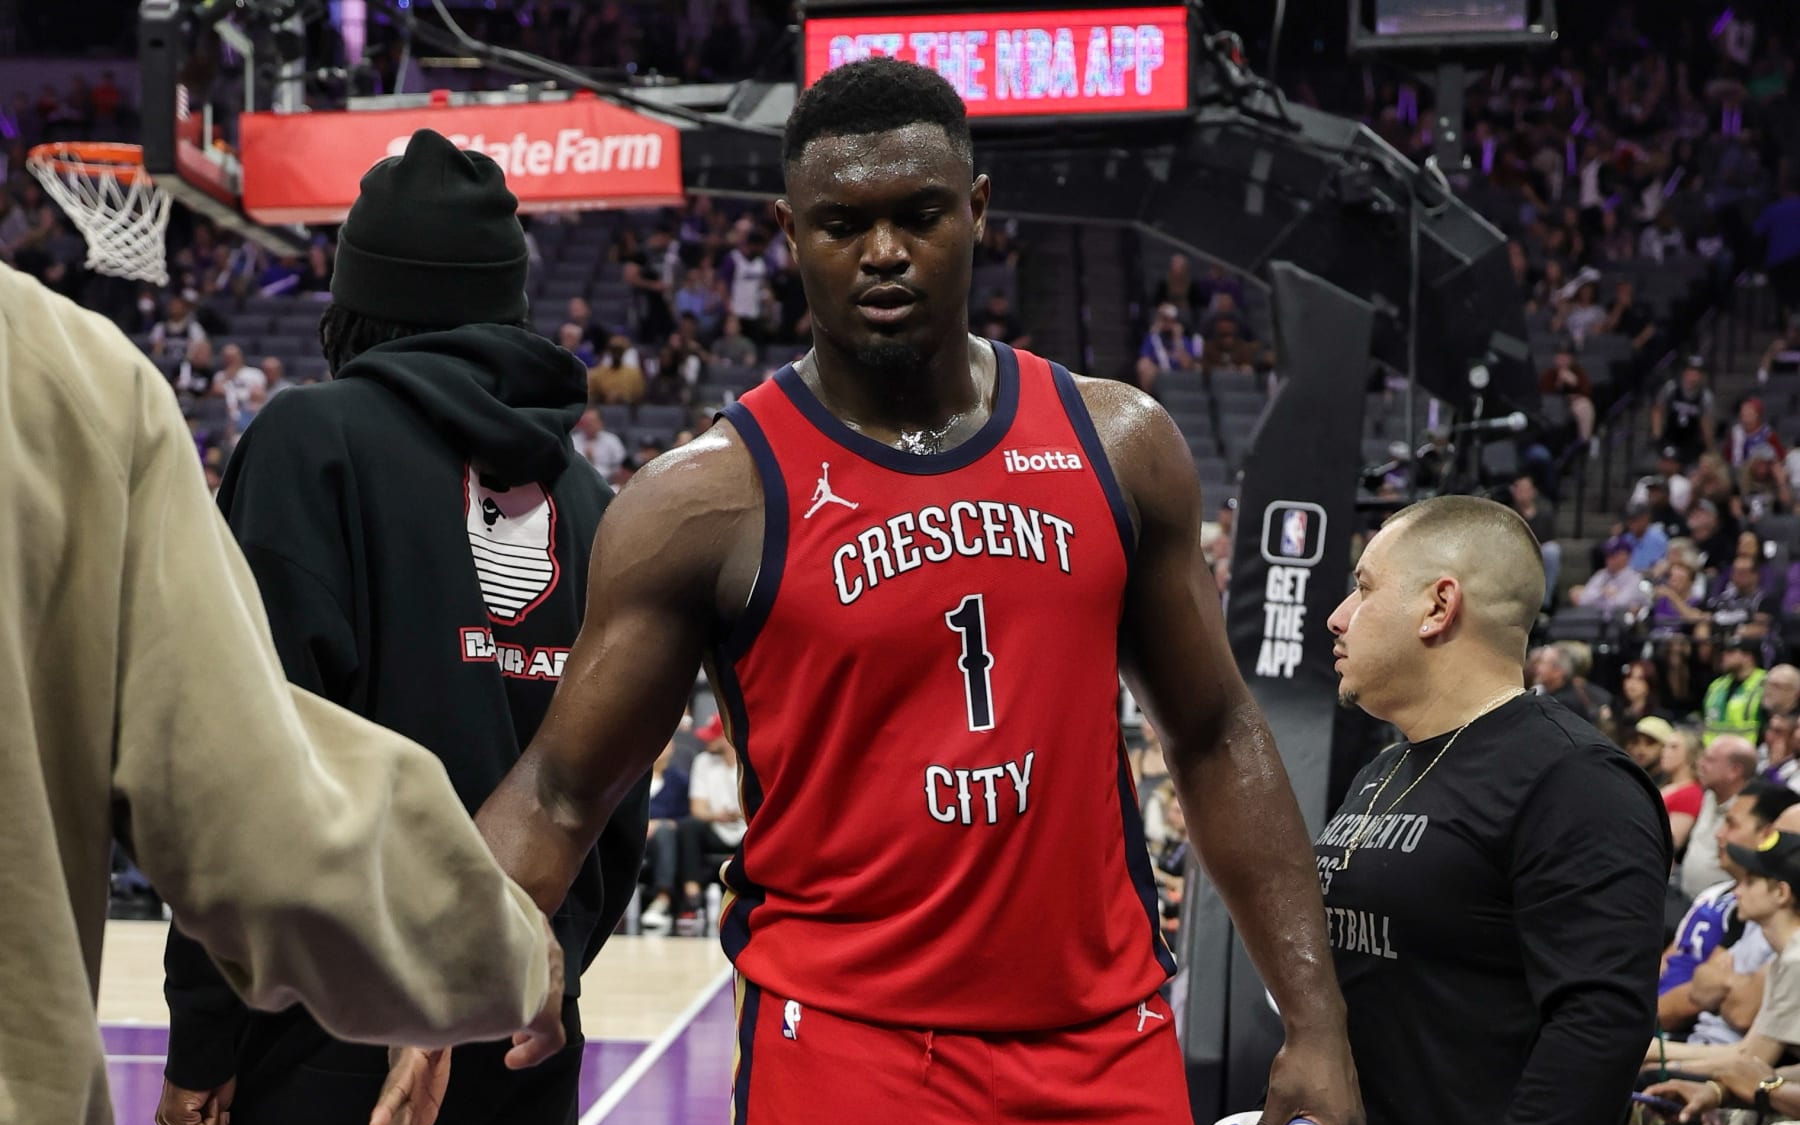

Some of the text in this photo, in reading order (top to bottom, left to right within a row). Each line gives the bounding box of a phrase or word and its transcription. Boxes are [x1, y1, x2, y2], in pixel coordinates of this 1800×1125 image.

[995, 28, 1079, 99] NBA
[1084, 25, 1164, 97] APP
[1003, 450, 1083, 473] ibotta
[831, 500, 1075, 605] CRESCENT
[1265, 564, 1311, 604] GET
[1263, 602, 1307, 641] THE
[944, 593, 995, 732] 1
[1256, 638, 1303, 679] APP
[924, 750, 1035, 825] CITY
[1324, 906, 1399, 960] ETBALL
